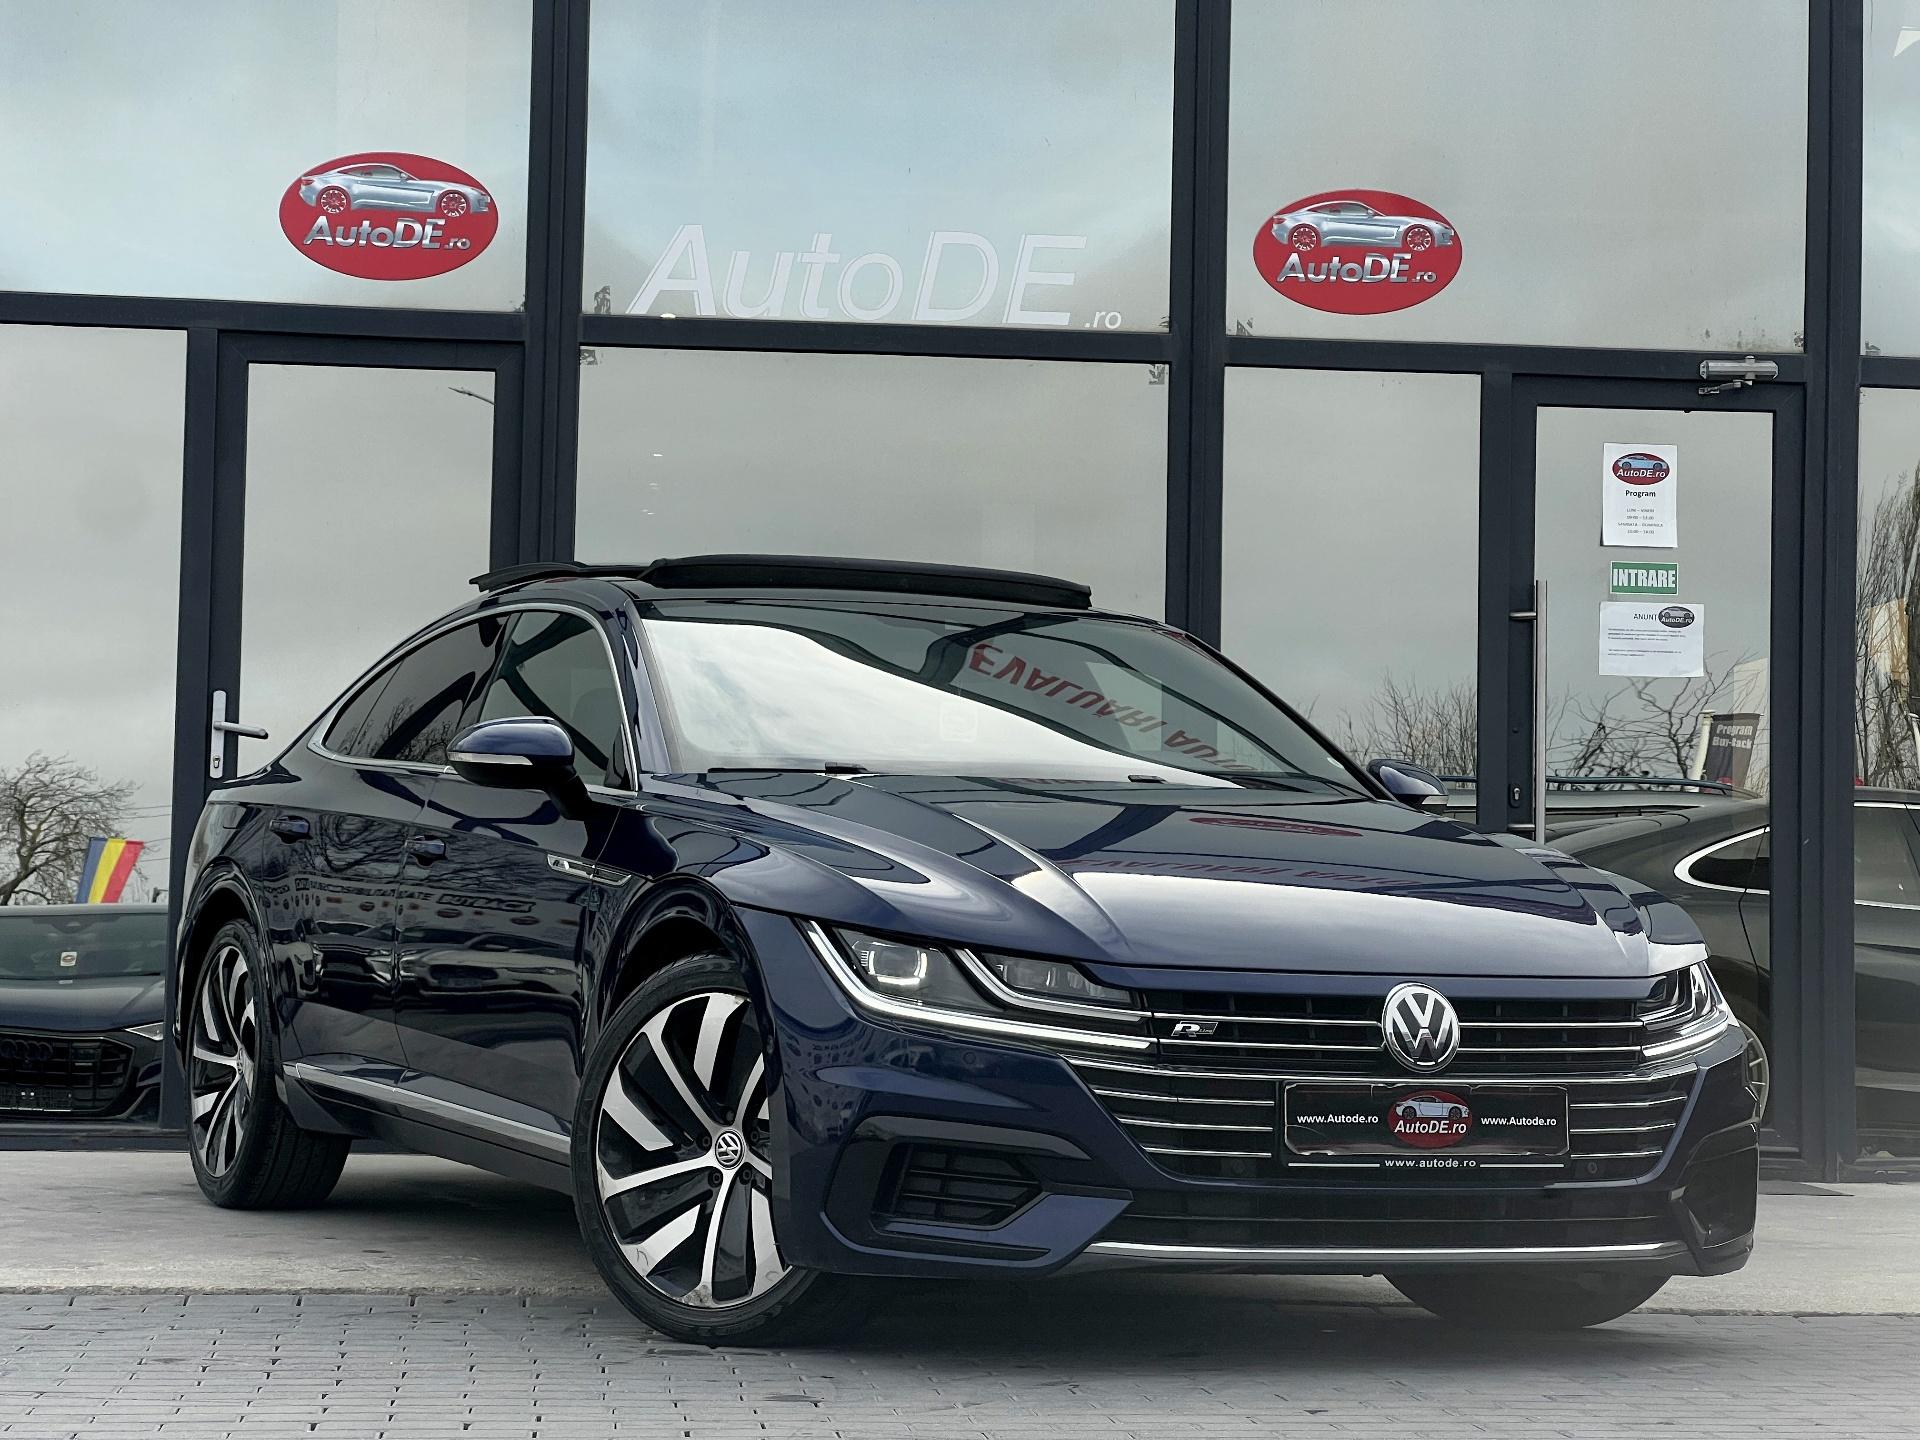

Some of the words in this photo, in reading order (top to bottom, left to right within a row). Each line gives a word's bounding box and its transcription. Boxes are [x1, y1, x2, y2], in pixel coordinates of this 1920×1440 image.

[1616, 468, 1666, 478] AutoDE.ro
[1625, 490, 1656, 498] Program
[1612, 568, 1676, 588] INTRARE
[1716, 724, 1753, 736] Program
[1297, 1113, 1379, 1124] www.Autode.ro
[1481, 1115, 1557, 1126] www.Autode.ro
[1394, 1120, 1467, 1134] AutoDE.ro
[1384, 1158, 1477, 1168] www.autode.ro
